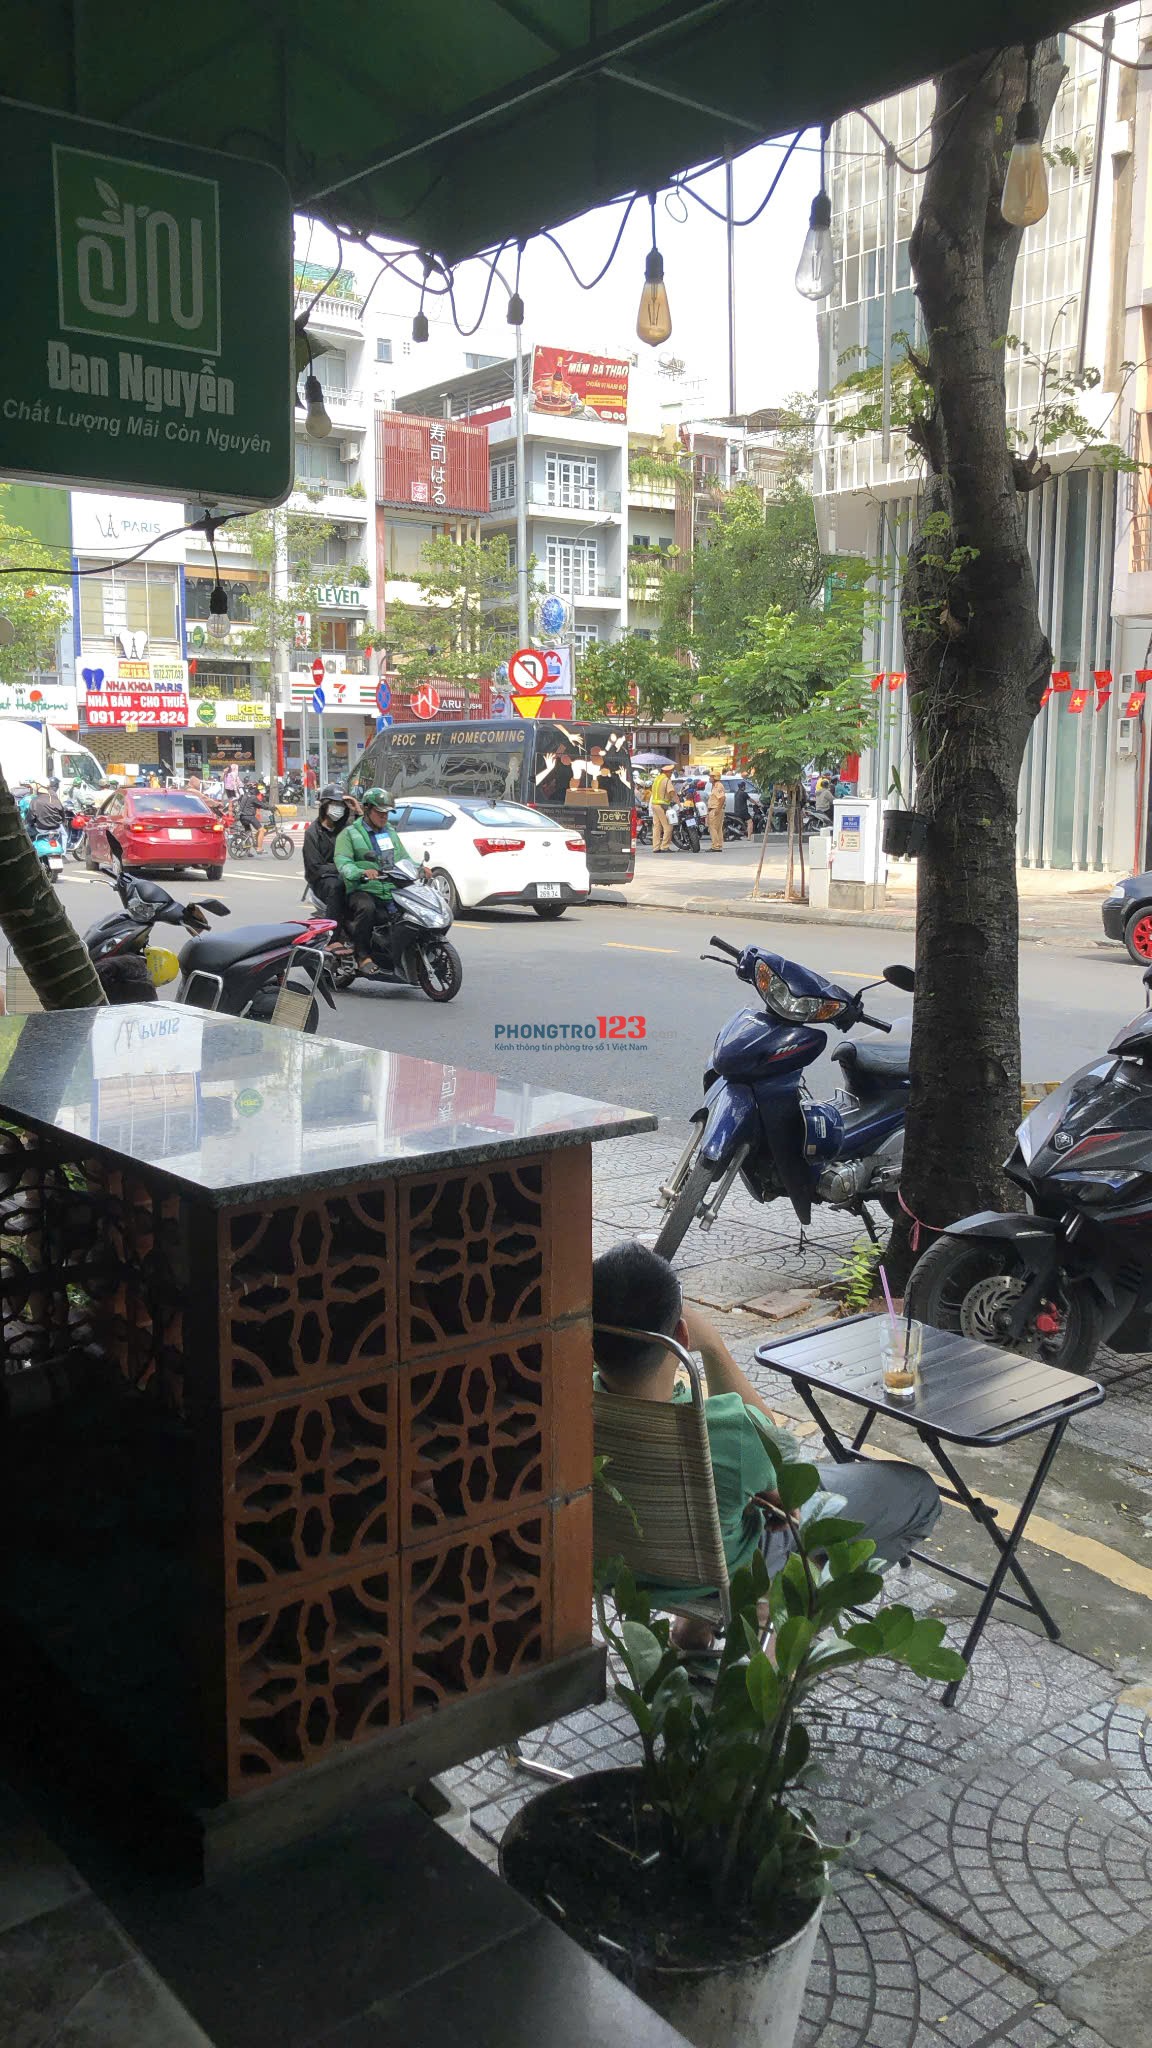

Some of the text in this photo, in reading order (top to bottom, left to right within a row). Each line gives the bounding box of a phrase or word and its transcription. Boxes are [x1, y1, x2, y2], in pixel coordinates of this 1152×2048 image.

[47, 340, 235, 418] Đan Nguyễn
[2, 399, 271, 454] Chất Lượng Mãi Còn Nguyên
[430, 423, 446, 505] 寿司はる
[121, 520, 161, 534] PARIS
[106, 681, 183, 692] NHA KHOA PARIS
[88, 693, 109, 707] NHÀ
[110, 694, 131, 708] BÁN
[140, 696, 160, 708] CHO
[161, 694, 185, 708] THUÊ
[89, 710, 186, 724] 091.2222.824
[391, 730, 525, 747] PEOC PET HOMECOMING
